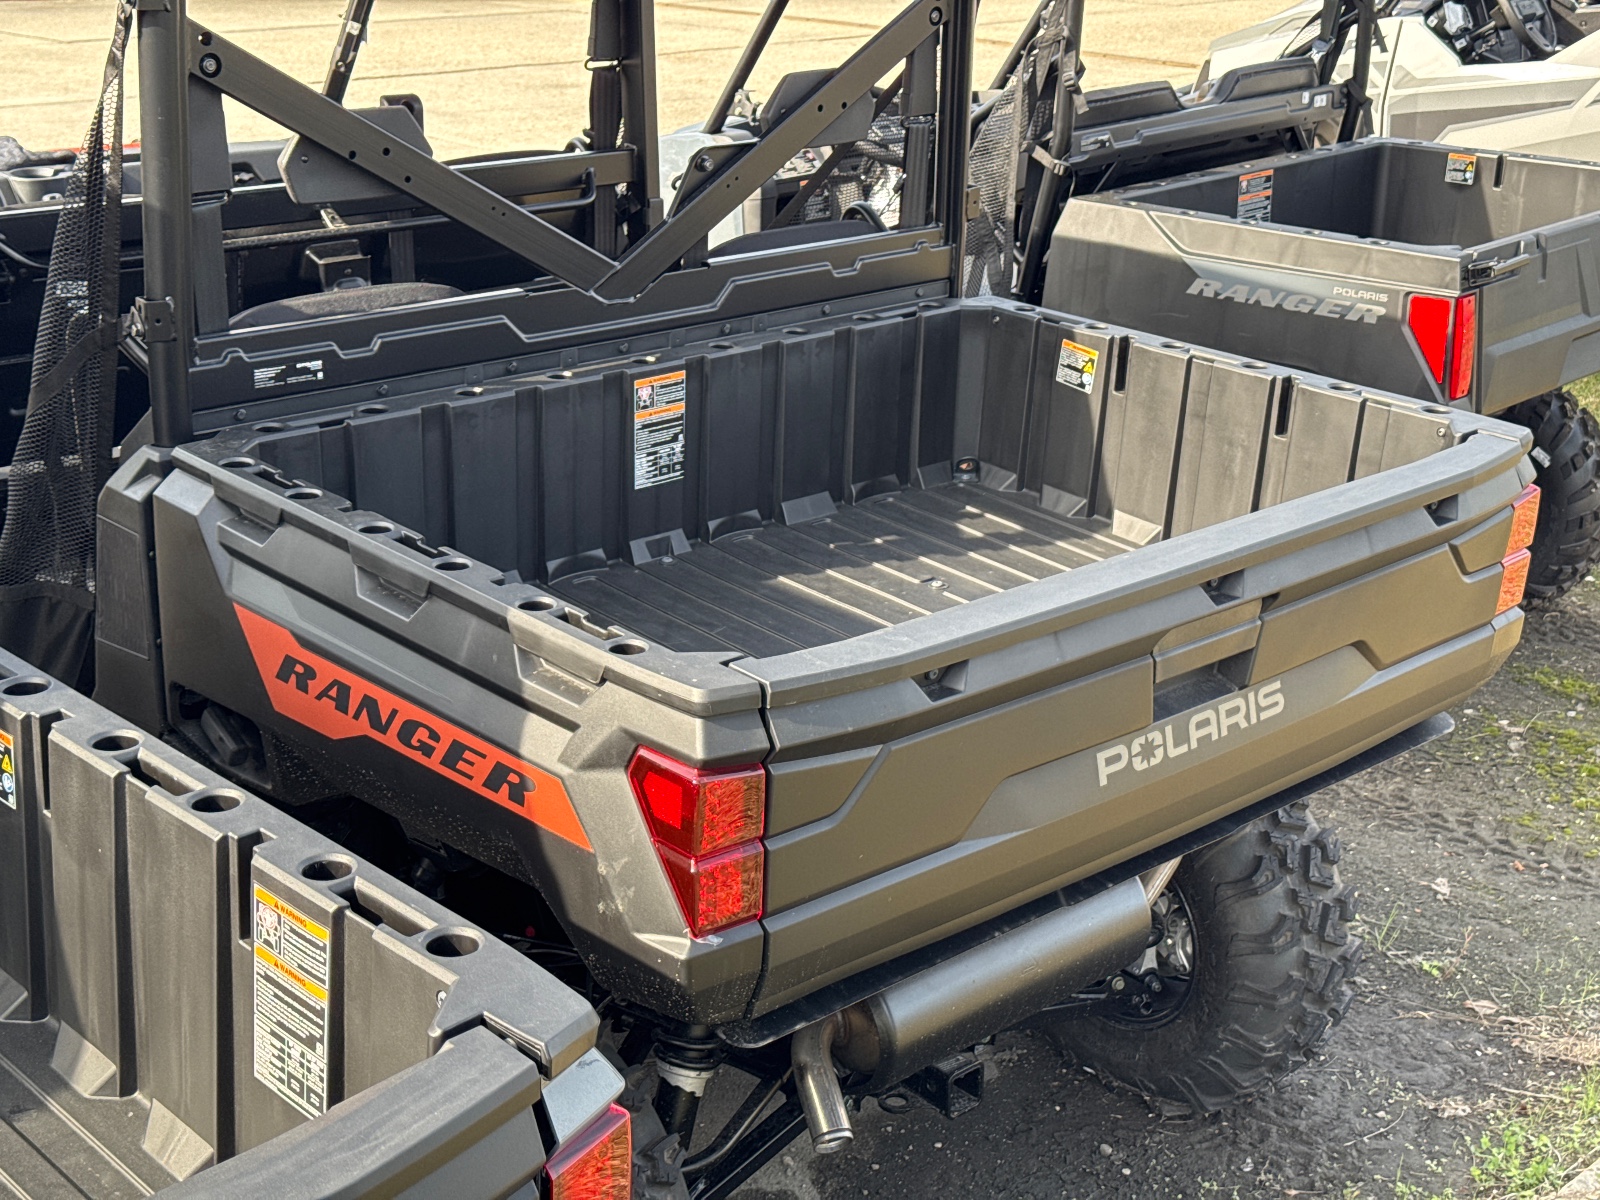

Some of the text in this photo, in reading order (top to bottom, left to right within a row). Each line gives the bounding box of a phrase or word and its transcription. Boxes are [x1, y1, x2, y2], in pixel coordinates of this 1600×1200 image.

[1185, 277, 1387, 324] RANGER
[1333, 286, 1389, 303] POLARIS
[275, 654, 537, 808] RANGER
[1096, 680, 1285, 787] POLARIS
[280, 904, 307, 928] WARNING
[280, 962, 307, 987] WARNING
